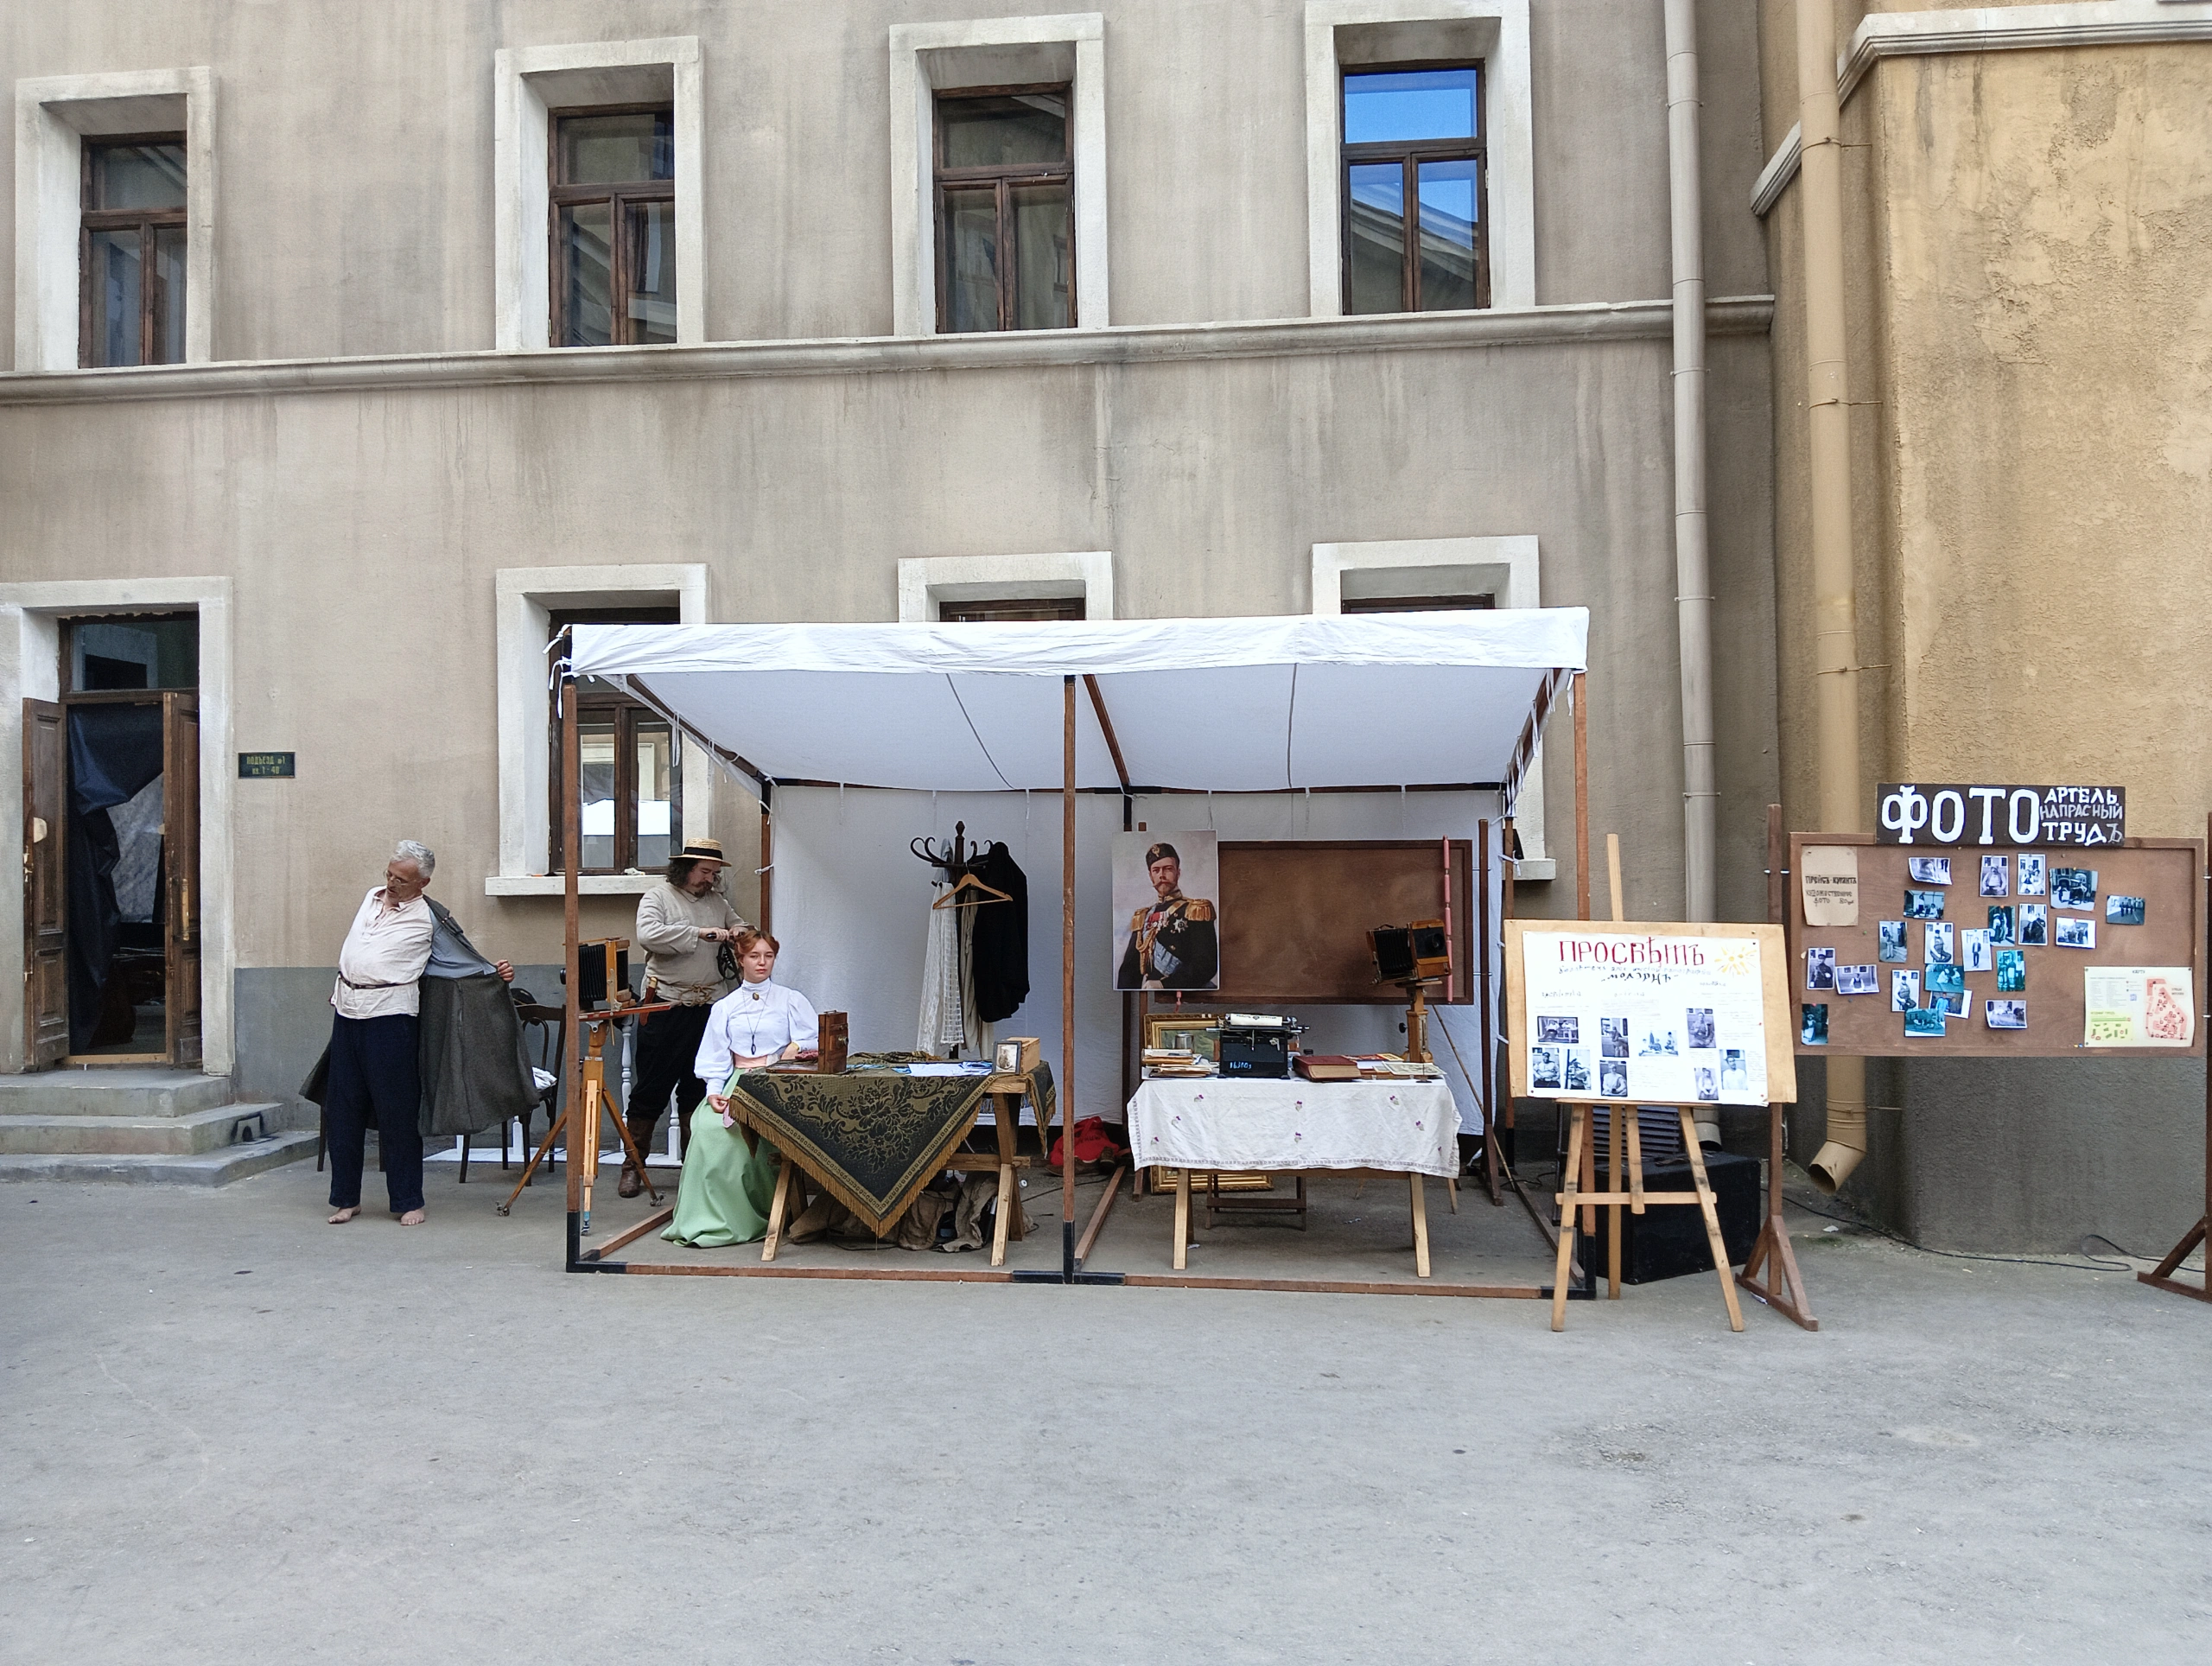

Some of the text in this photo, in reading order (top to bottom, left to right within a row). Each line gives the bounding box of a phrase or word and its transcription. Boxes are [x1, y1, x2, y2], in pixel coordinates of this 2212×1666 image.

[246, 756, 275, 765] ПОДЪЕЗД
[1881, 785, 2041, 845] ФОТО
[2042, 822, 2123, 846] ТРУДЪ
